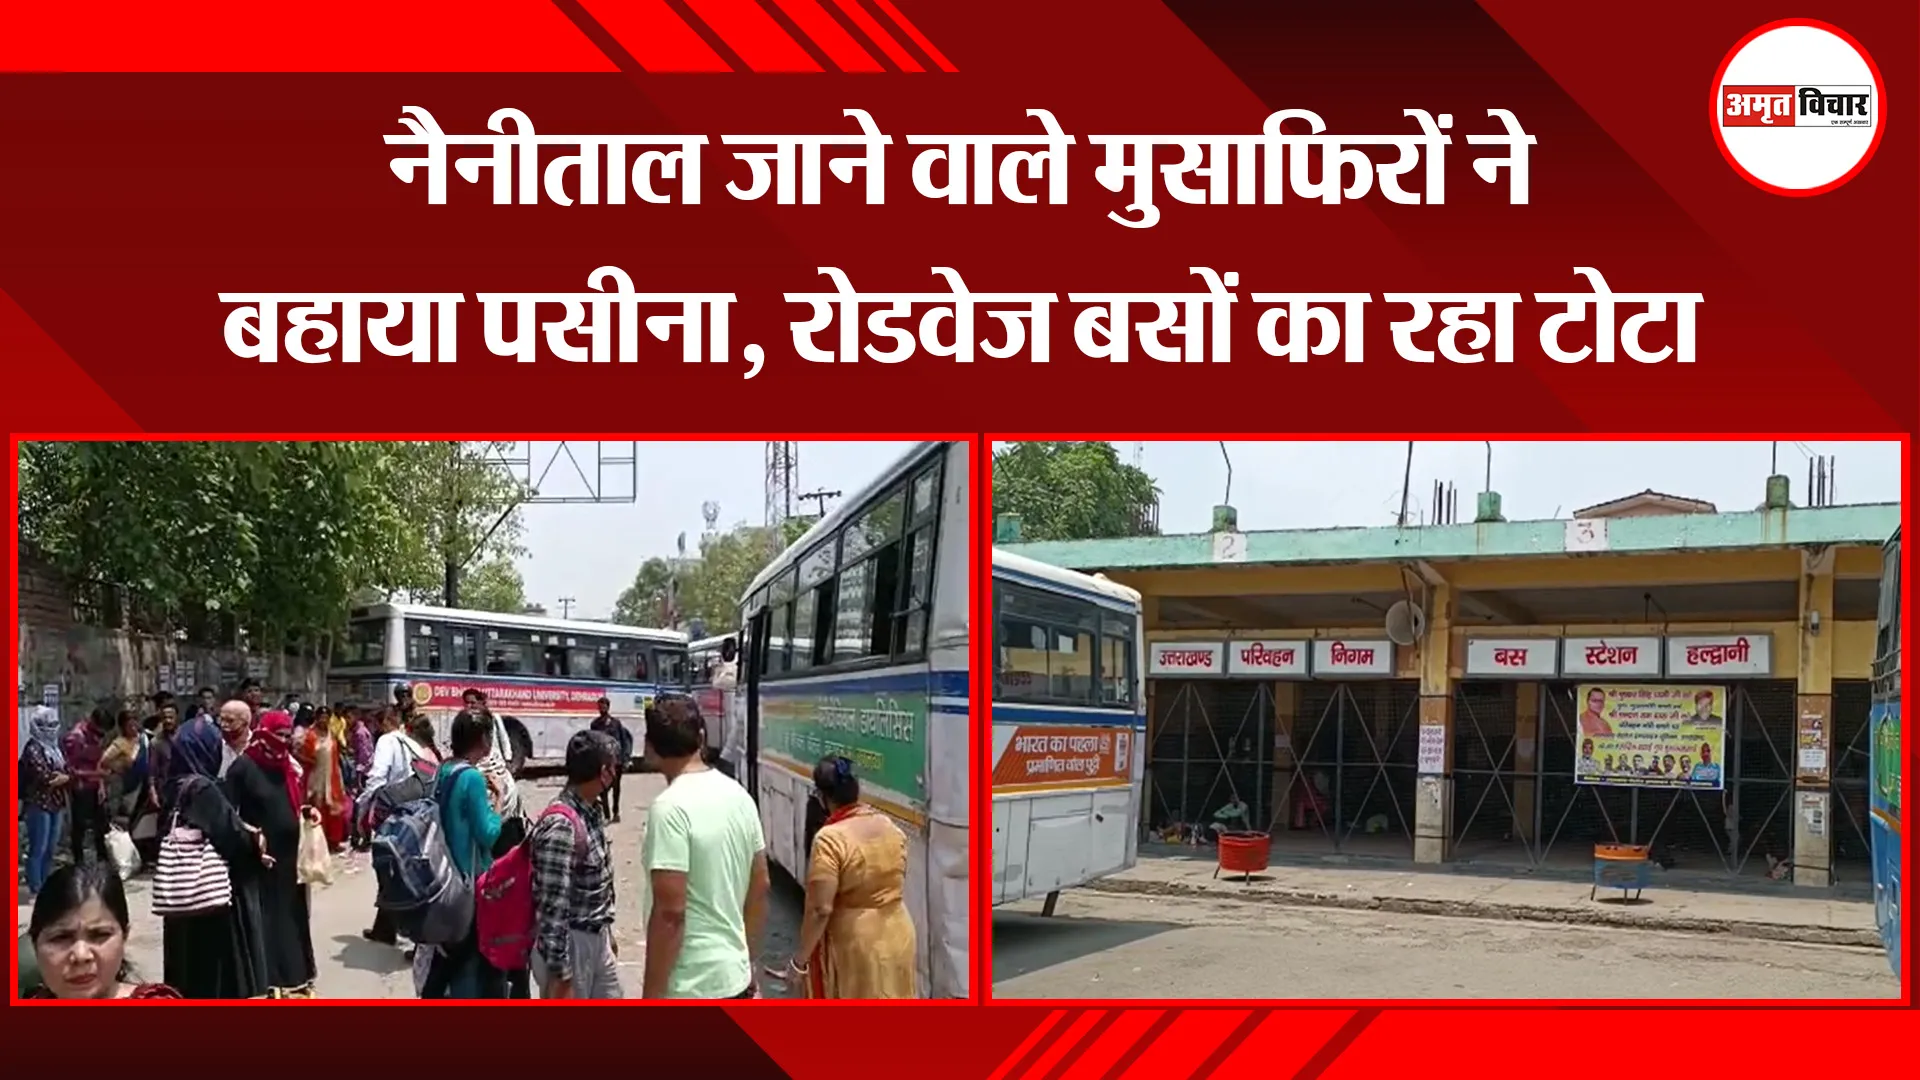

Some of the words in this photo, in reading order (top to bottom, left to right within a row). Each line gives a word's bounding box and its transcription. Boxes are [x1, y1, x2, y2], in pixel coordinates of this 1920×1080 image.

[1222, 535, 1236, 559] 2
[1159, 650, 1213, 667] उत्तराखण्ड
[1241, 642, 1295, 667] परिवहन
[1331, 641, 1374, 665] निगम
[1494, 647, 1528, 666] बस
[1585, 640, 1638, 665] स्टेशन
[1686, 637, 1750, 666] हल्द्वानी
[434, 688, 450, 697] DEV
[1015, 735, 1048, 753] भारत
[1049, 735, 1067, 752] का
[1069, 735, 1099, 752] पहला
